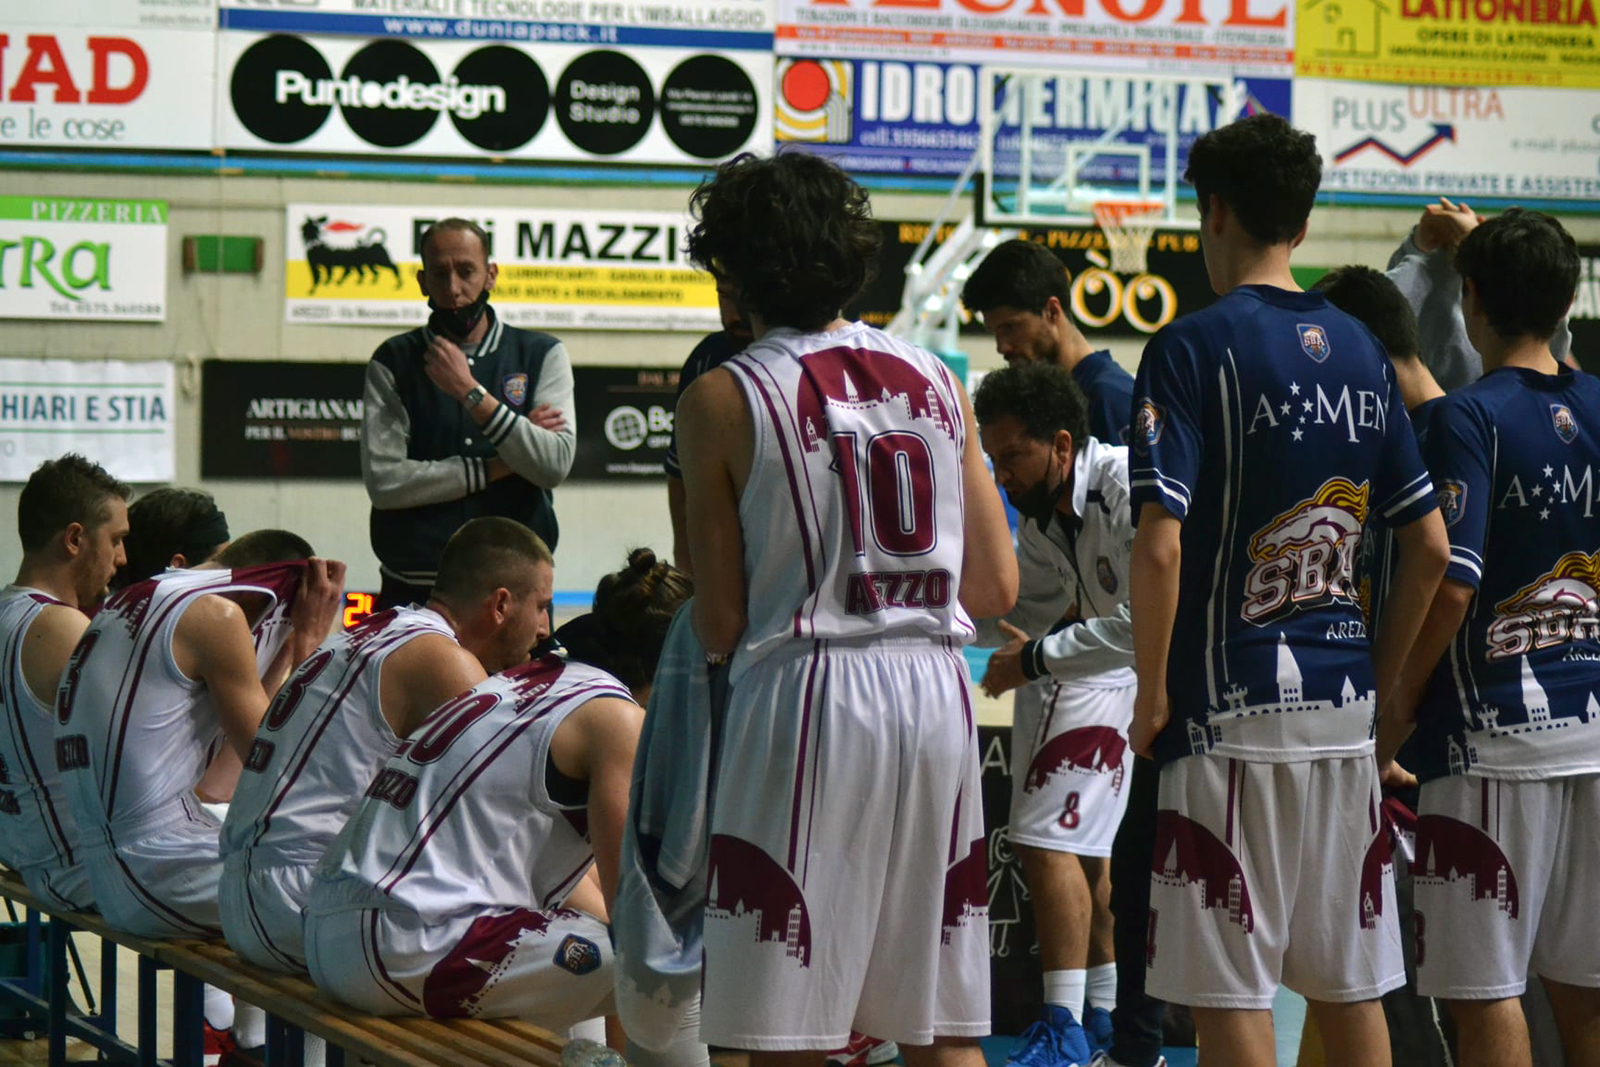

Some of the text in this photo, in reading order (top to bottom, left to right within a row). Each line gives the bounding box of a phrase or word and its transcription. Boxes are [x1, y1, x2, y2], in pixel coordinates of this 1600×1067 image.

[589, 5, 625, 20] PER
[384, 17, 618, 42] www.duniapack.it
[570, 80, 640, 104] Design
[570, 103, 640, 124] Studio
[1333, 86, 1506, 133] PLUS ULTRA
[29, 108, 51, 139] le
[64, 117, 126, 141] cose
[1424, 173, 1499, 190] PRIVATE
[31, 200, 163, 223] PIZZERIA
[516, 221, 677, 262] MAZZI
[86, 397, 99, 421] E
[108, 396, 167, 422] STIA
[1241, 533, 1365, 624] SBA
[1058, 791, 1080, 830] 8
